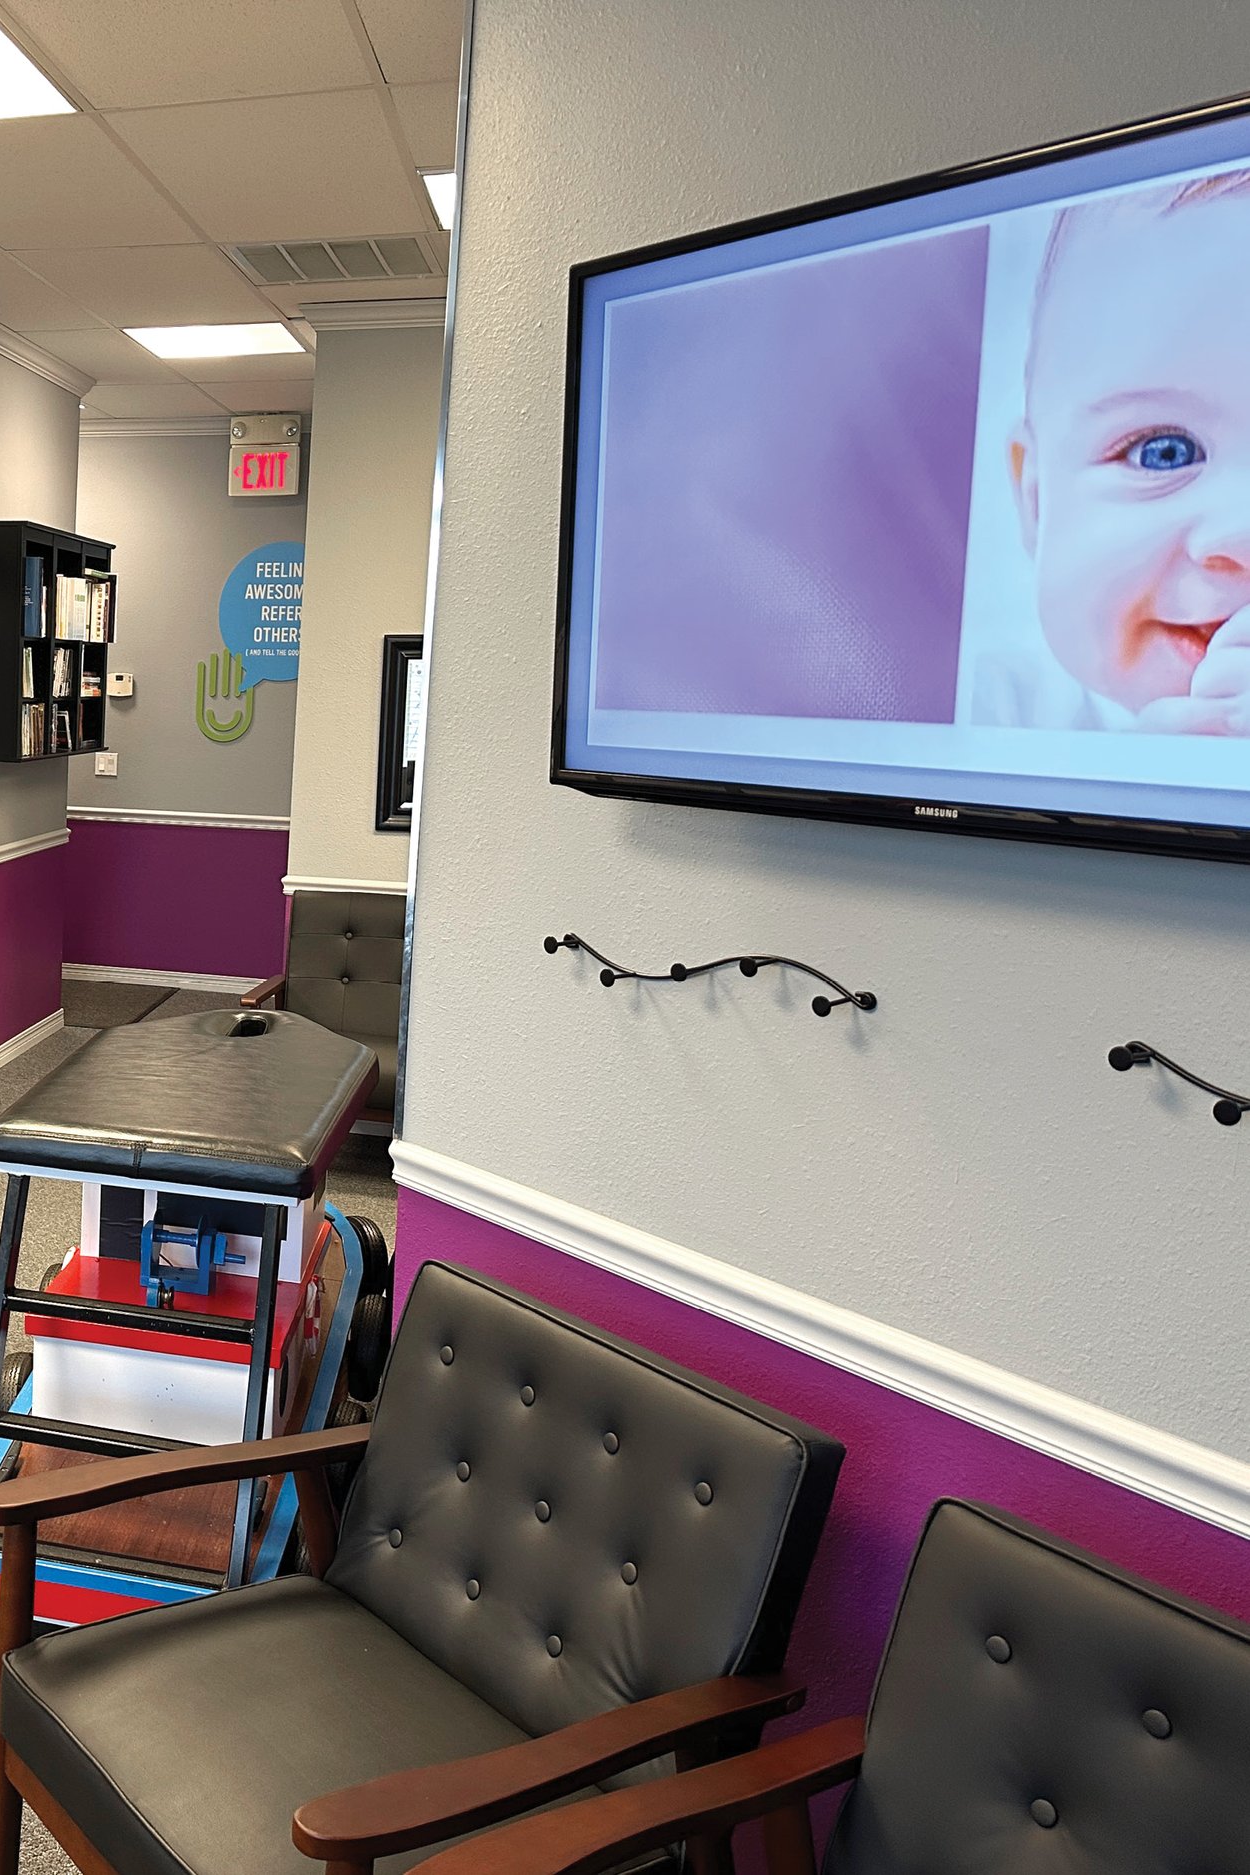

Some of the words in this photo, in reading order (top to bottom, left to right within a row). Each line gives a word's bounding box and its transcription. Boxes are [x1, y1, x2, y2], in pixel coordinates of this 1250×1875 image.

[242, 451, 289, 489] EXIT
[256, 562, 303, 578] FEELIN
[244, 584, 304, 600] AWESOM
[261, 605, 302, 621] REFER
[249, 649, 261, 657] AND
[262, 649, 275, 657] TELL
[276, 649, 287, 657] THE
[287, 649, 300, 657] GOO
[914, 806, 958, 818] SAMSUNG
